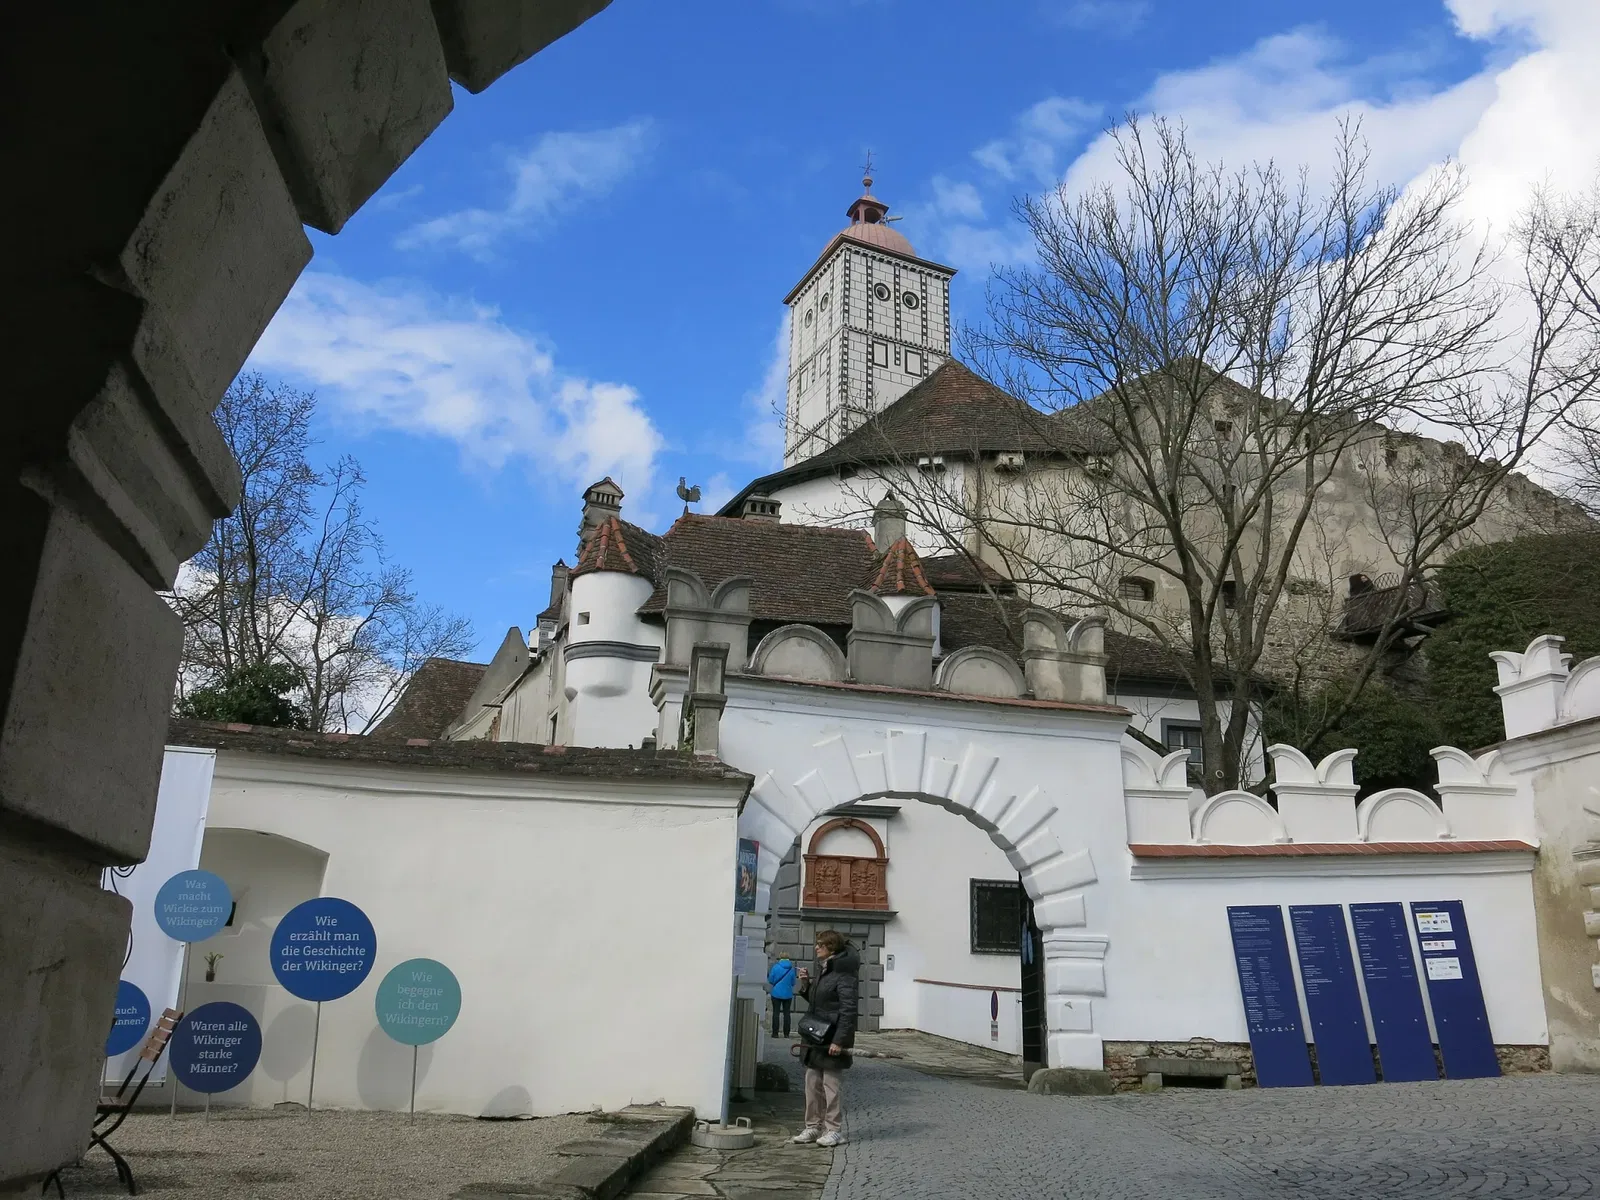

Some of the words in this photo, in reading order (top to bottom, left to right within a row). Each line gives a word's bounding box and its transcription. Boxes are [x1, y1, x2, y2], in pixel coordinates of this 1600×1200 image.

[185, 880, 207, 889] Was
[178, 892, 211, 900] macht
[163, 904, 199, 913] Wickie
[166, 916, 219, 928] Wikinger?
[315, 916, 338, 926] Wie
[289, 930, 330, 941] erzählt
[334, 932, 360, 941] man
[281, 945, 300, 956] die
[302, 945, 366, 956] Geschichte
[282, 960, 302, 971] der
[304, 960, 364, 974] Wikinger?
[411, 971, 433, 982] Wie
[396, 984, 444, 998] begegne
[398, 998, 415, 1010] ich
[418, 1000, 439, 1011] den
[115, 1006, 138, 1015] auch
[384, 1012, 449, 1028] Wikingern?
[190, 1021, 226, 1031] Waren
[228, 1021, 248, 1032] alle
[193, 1034, 242, 1048] Wikinger
[198, 1048, 233, 1060] starke
[190, 1062, 239, 1074] Männer?
